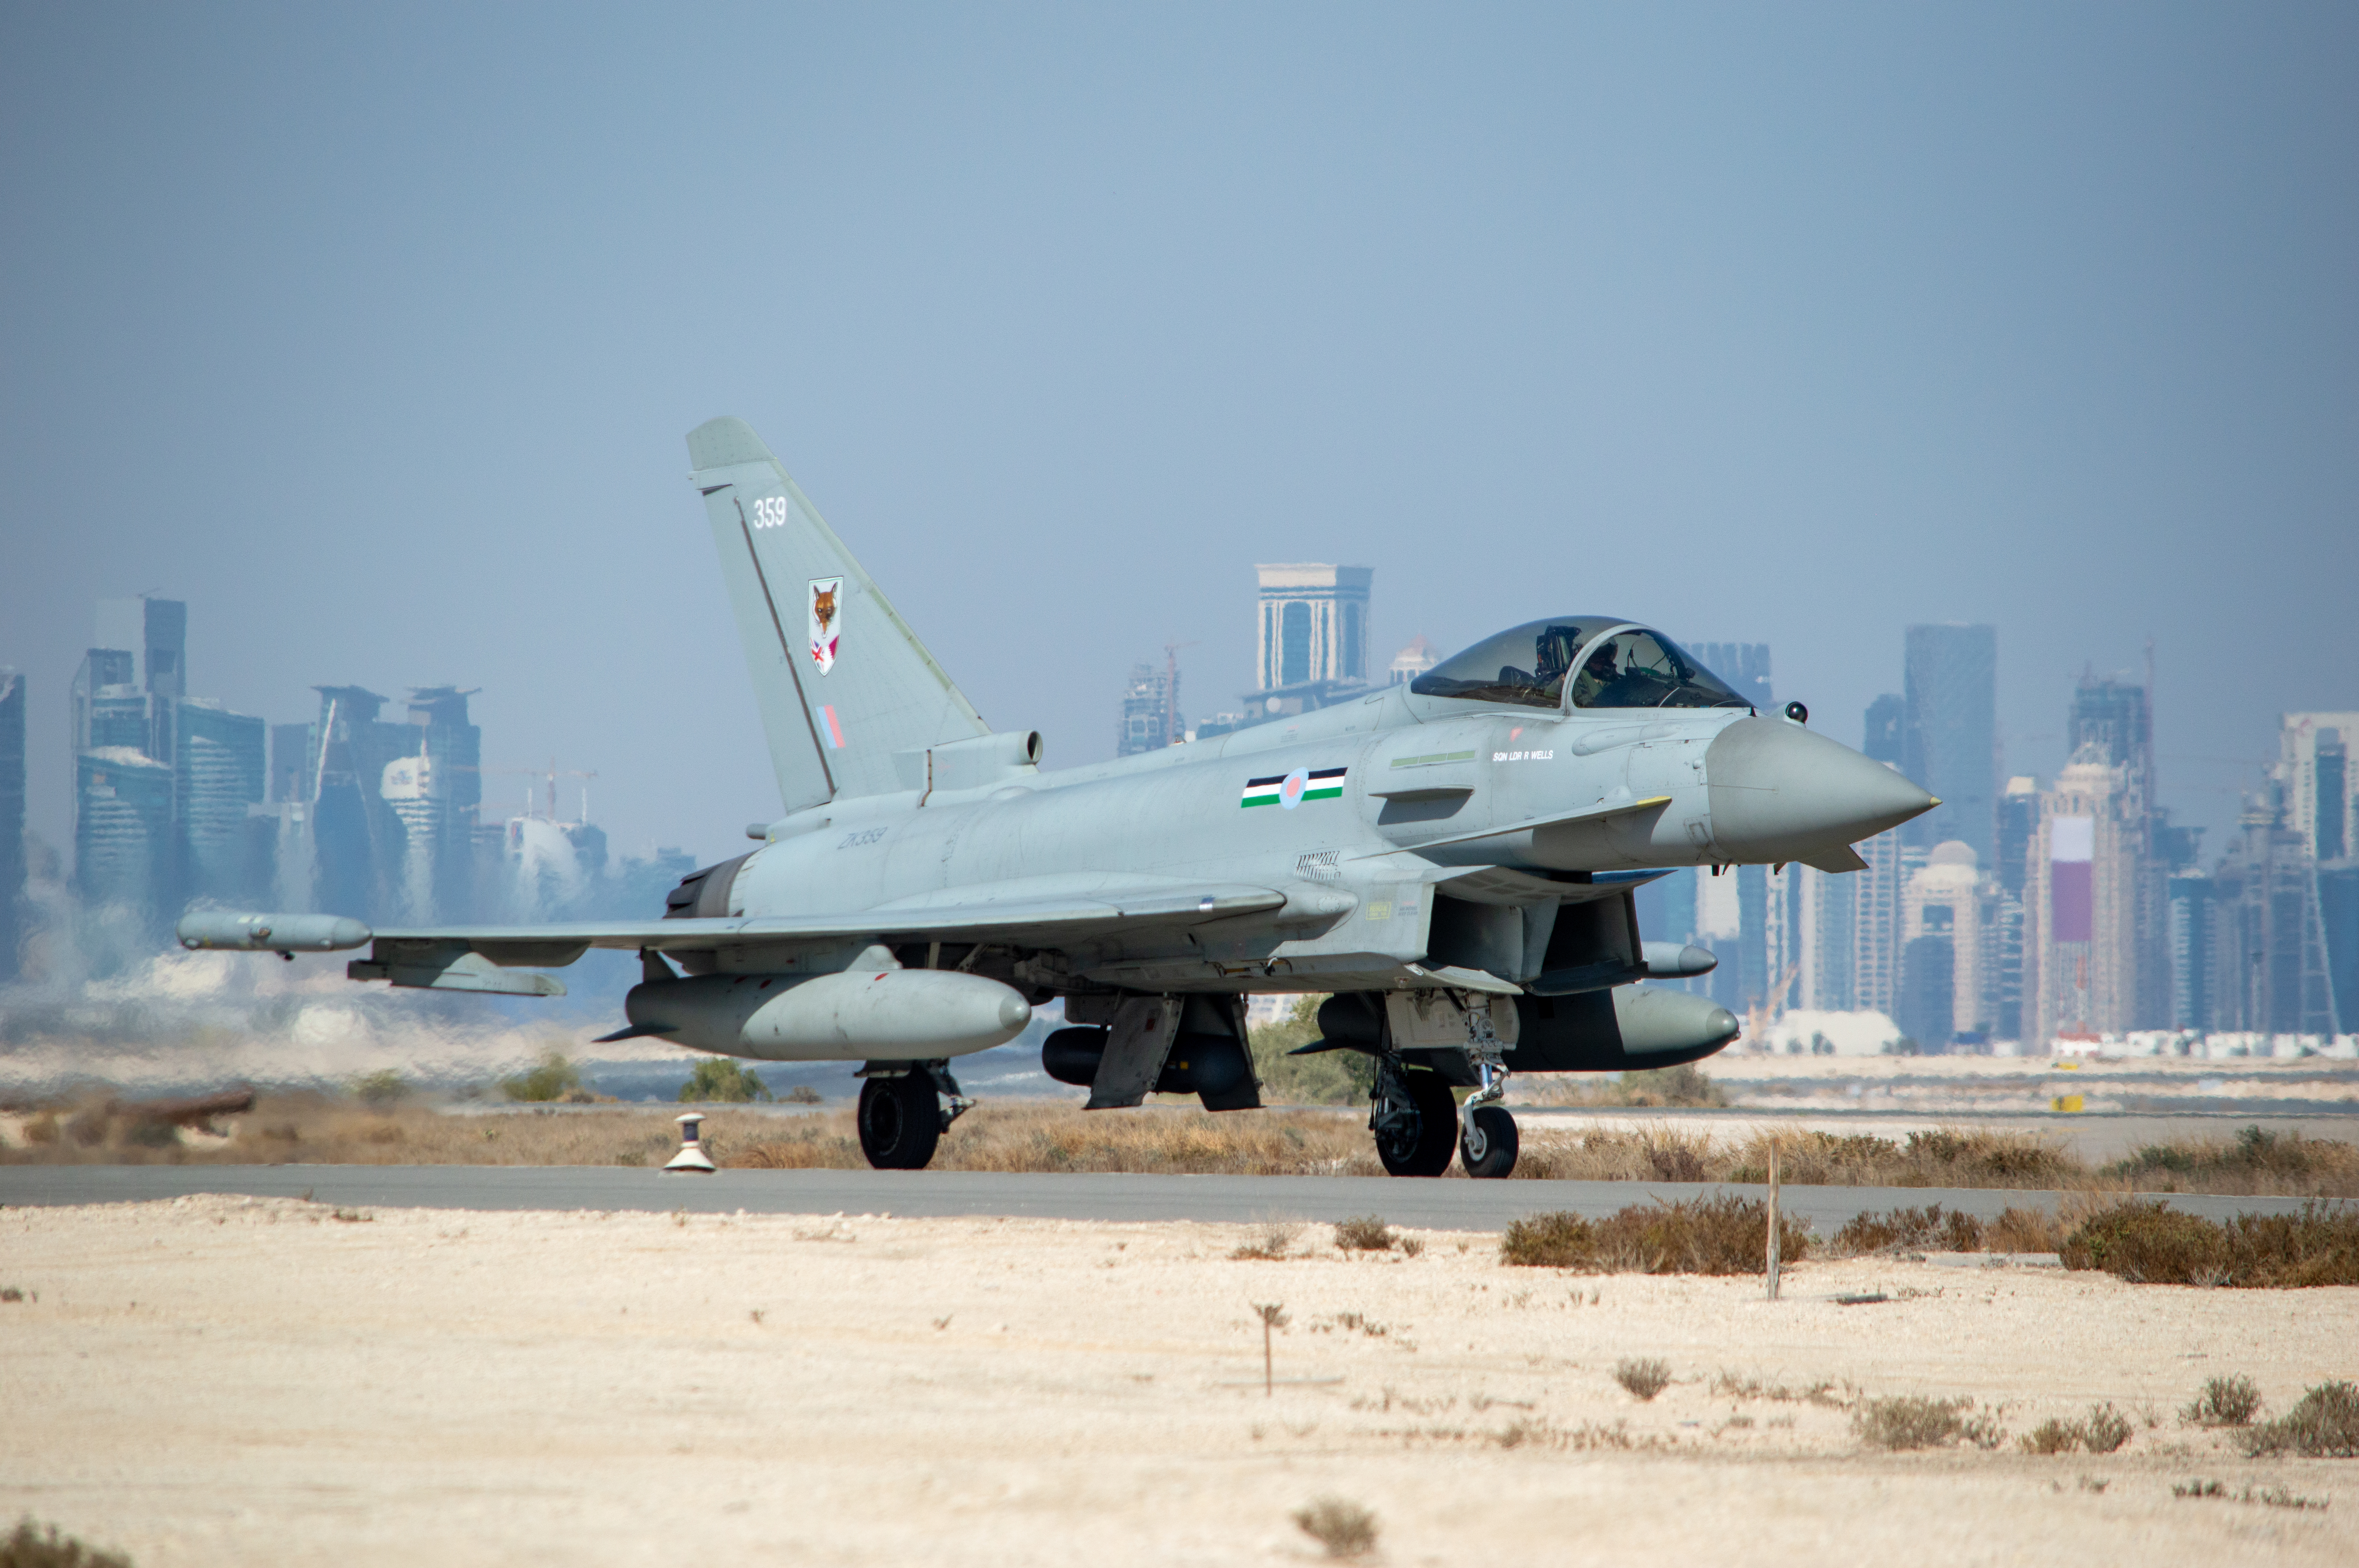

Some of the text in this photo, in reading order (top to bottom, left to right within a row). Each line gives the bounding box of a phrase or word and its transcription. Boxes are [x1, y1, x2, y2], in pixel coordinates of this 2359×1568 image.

[754, 496, 787, 529] 359
[1493, 750, 1554, 761] SQN LDR R WELLS
[837, 827, 887, 849] ZK359
